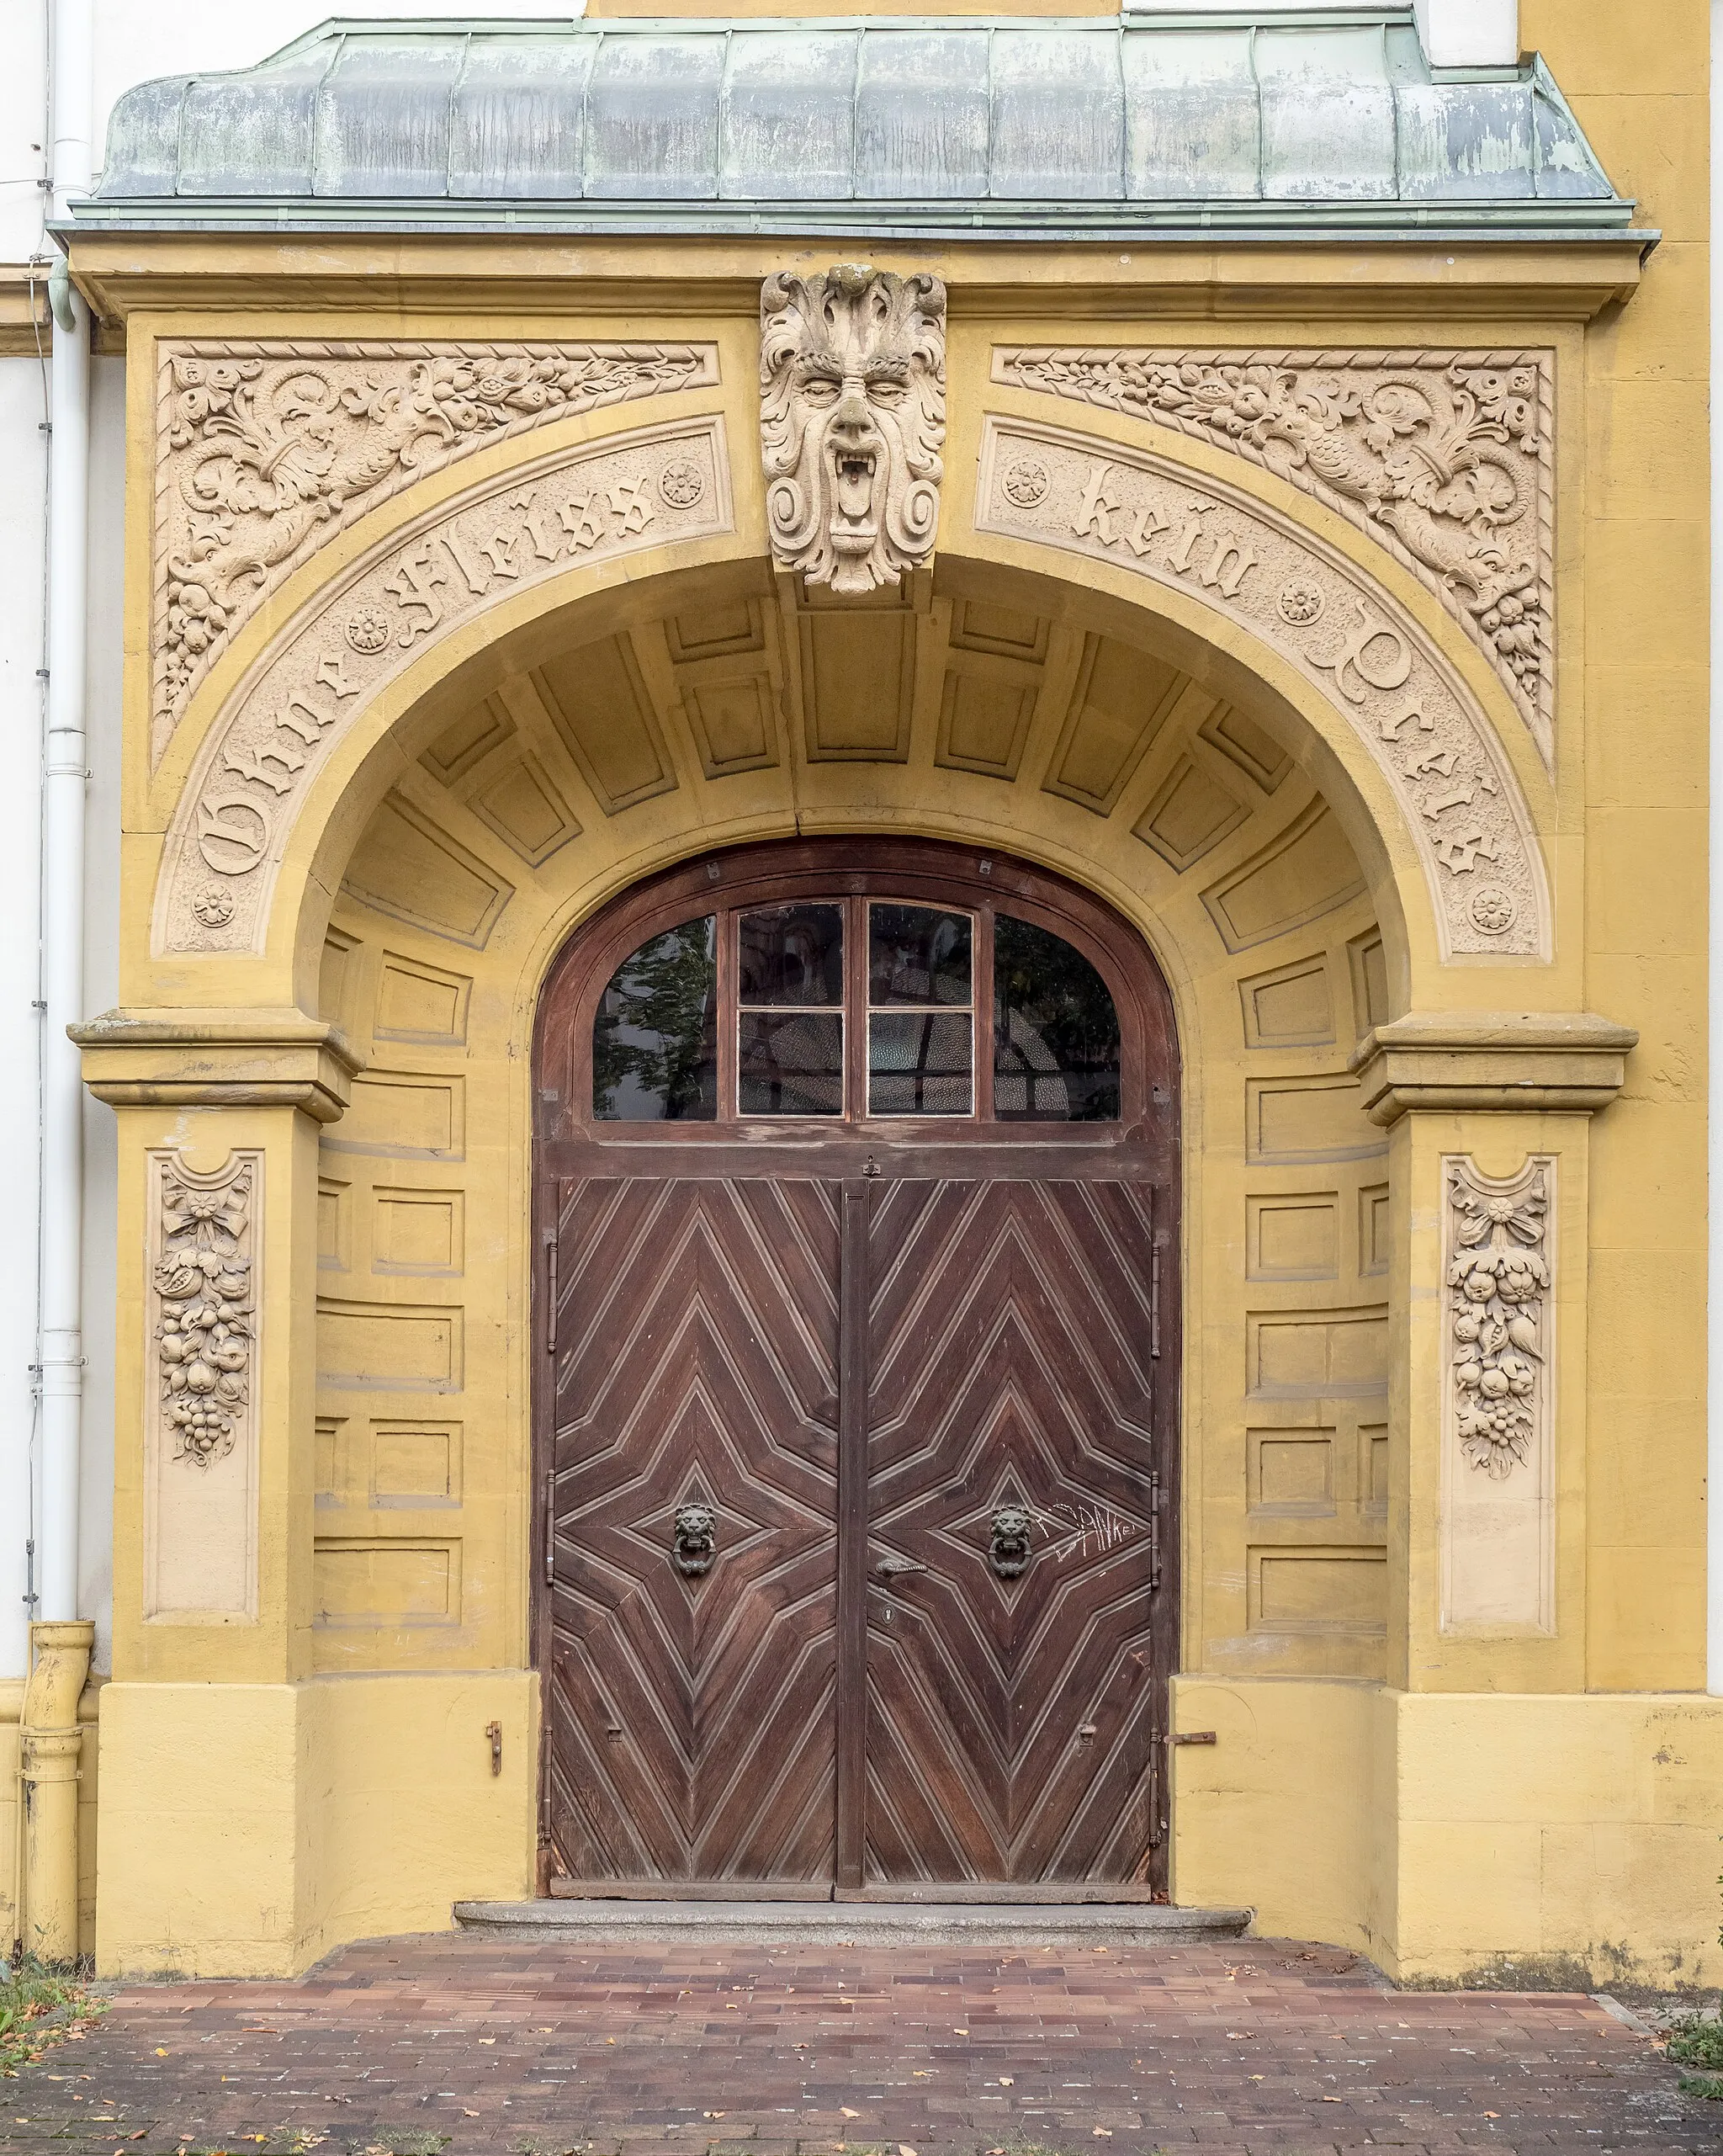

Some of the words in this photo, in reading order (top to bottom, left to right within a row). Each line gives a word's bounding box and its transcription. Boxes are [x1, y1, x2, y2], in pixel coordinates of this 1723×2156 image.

[195, 653, 360, 875] Ohne
[384, 474, 655, 648] Fleiss
[1071, 465, 1259, 598] kein
[1303, 596, 1498, 875] Preis
